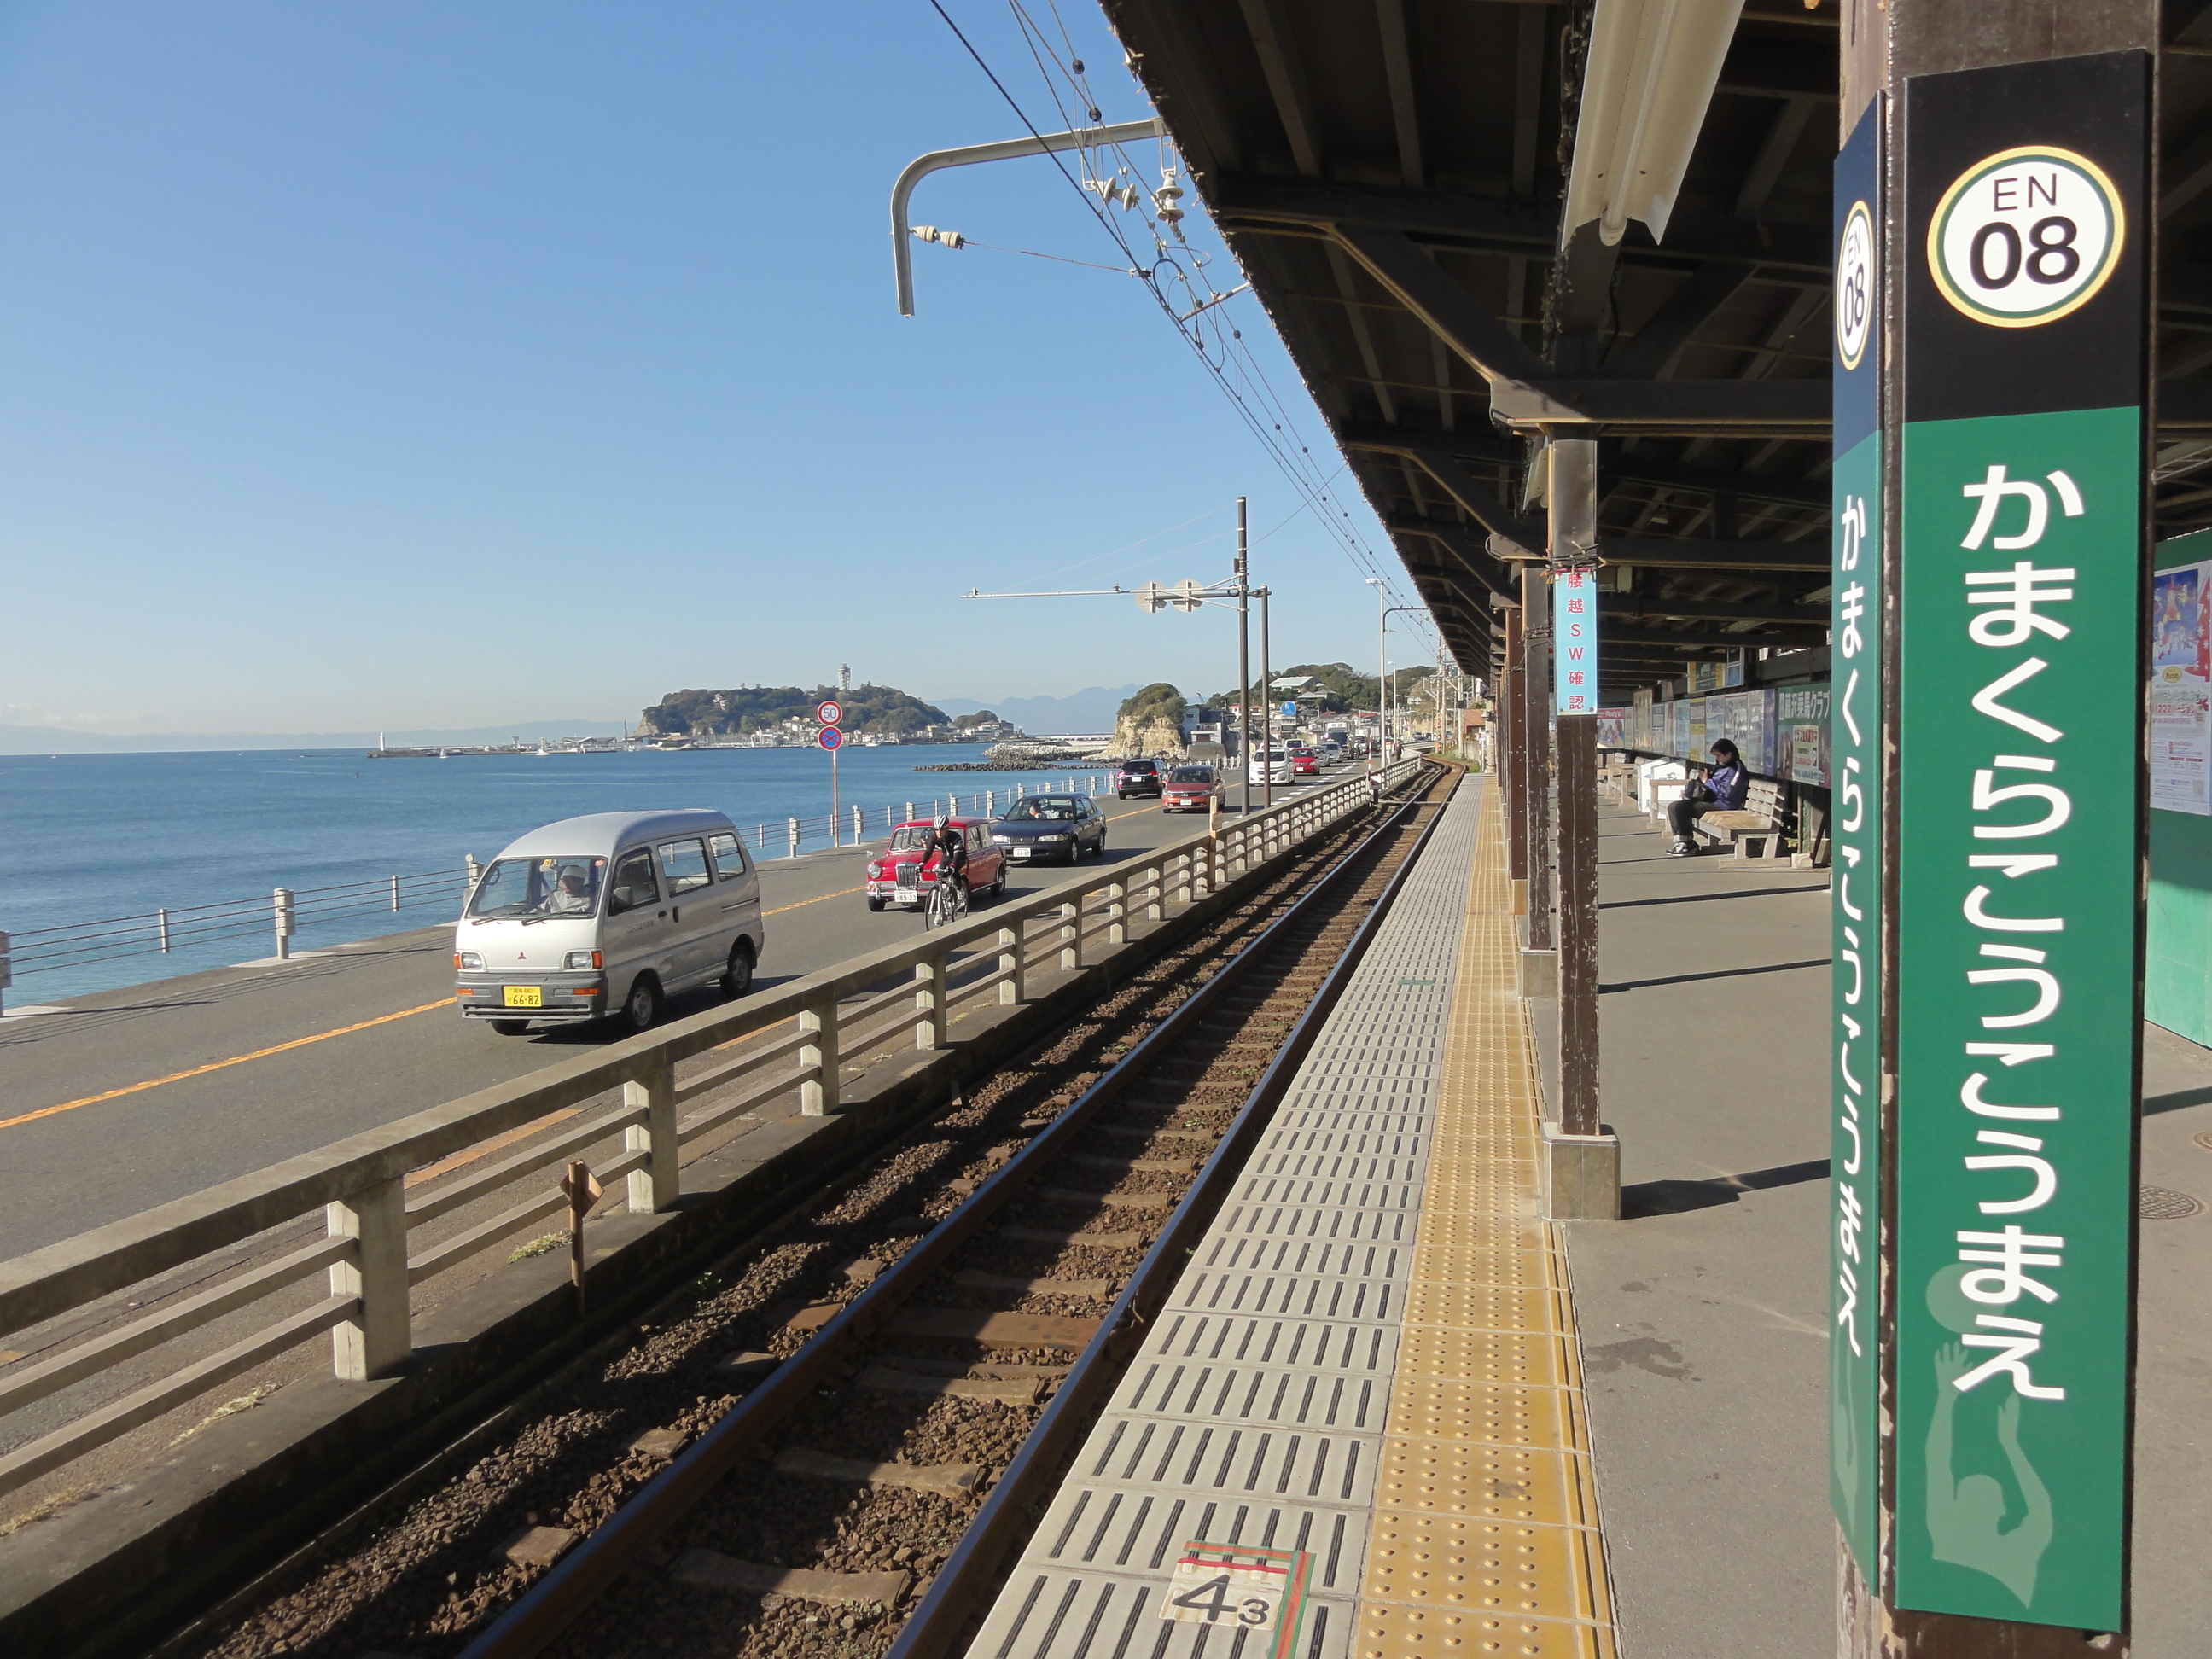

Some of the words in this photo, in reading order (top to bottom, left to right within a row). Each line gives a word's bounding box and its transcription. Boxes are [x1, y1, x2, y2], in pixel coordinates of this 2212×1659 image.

[1993, 174, 2058, 212] EN
[1848, 224, 1861, 267] EN
[1970, 215, 2080, 290] 08
[1845, 263, 1865, 338] 08
[1567, 573, 1585, 711] 腰越SW確認
[823, 707, 837, 719] 50
[1838, 495, 1866, 1358] かまくらこうこうまえ
[1953, 465, 2084, 1400] かまくらこうこうまえ
[513, 994, 539, 1004] 66-82
